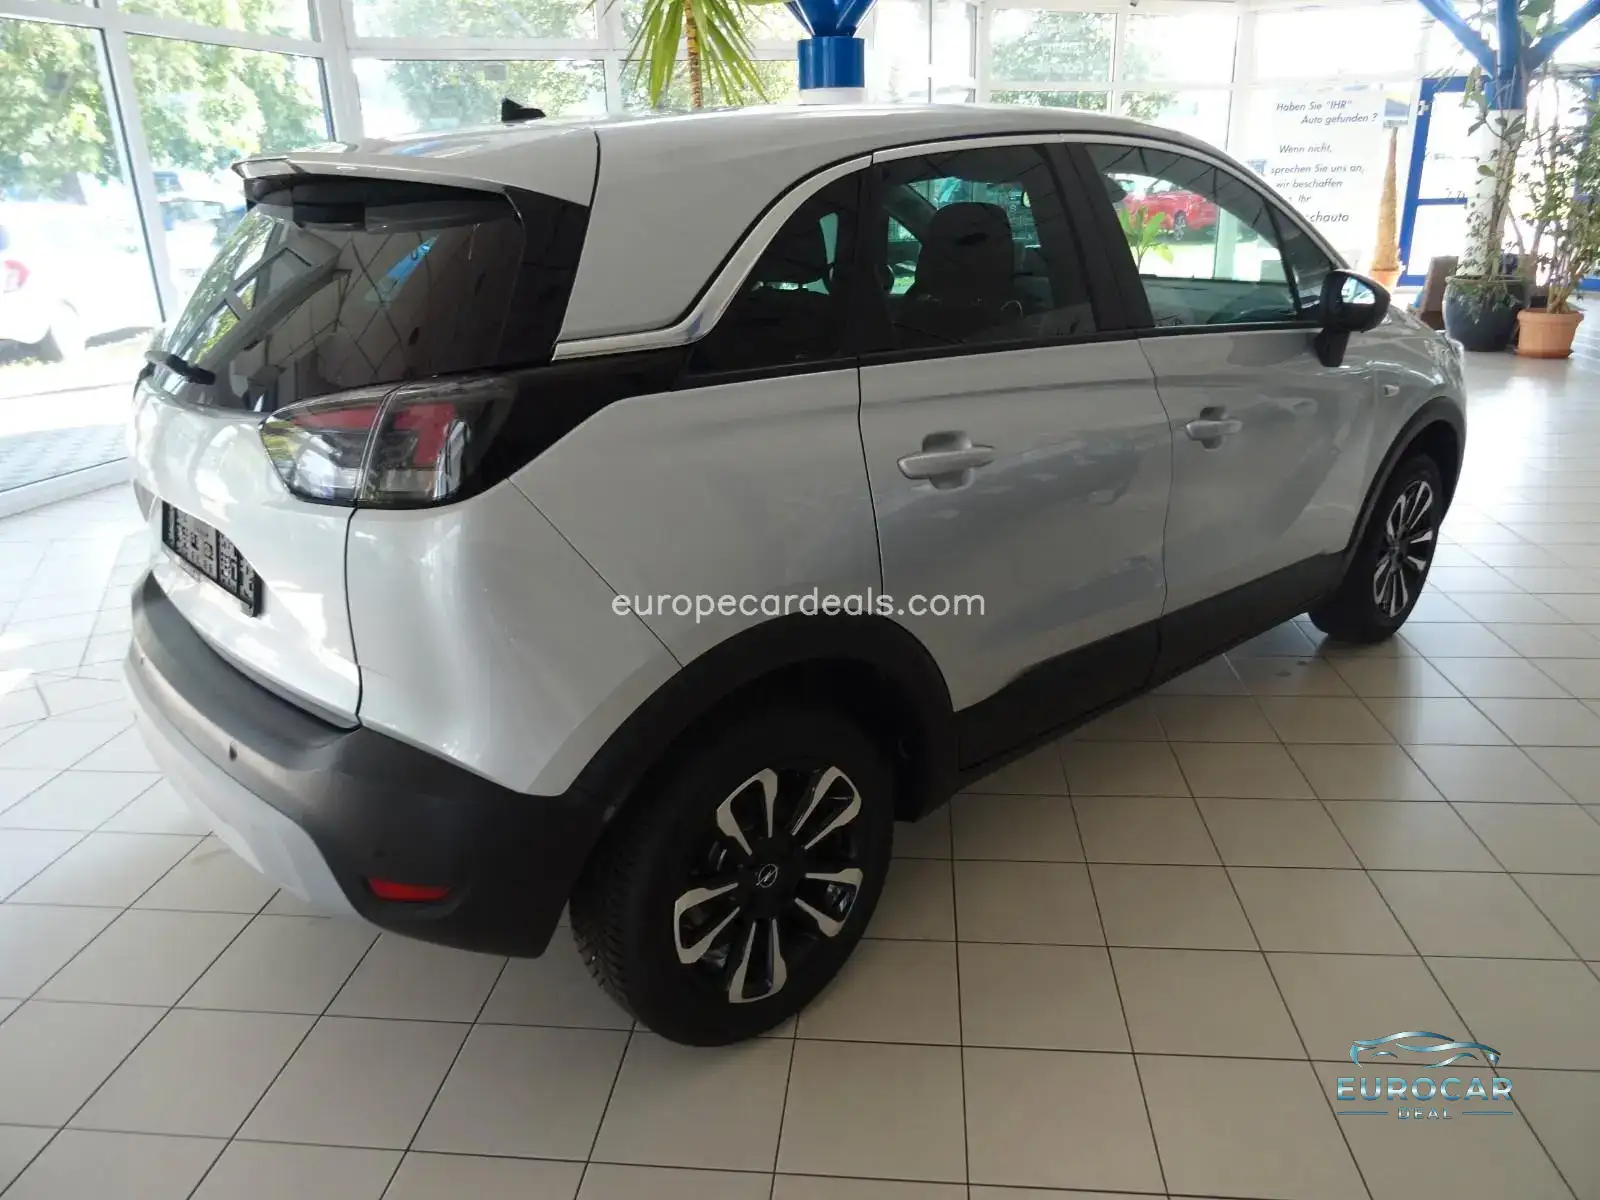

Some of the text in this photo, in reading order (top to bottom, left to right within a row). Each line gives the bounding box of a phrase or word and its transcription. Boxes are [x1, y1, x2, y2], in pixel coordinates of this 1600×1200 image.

[1276, 101, 1306, 111] Haben
[1309, 100, 1322, 110] Sie
[1301, 116, 1323, 124] Auto
[1325, 114, 1369, 126] gefunden
[1279, 144, 1305, 153] Wenn
[1271, 165, 1312, 175] sprechen
[1315, 164, 1329, 173] Sie
[1276, 179, 1343, 188] wir beschaffen
[1298, 195, 1312, 203] Ihr
[1306, 211, 1350, 223] chauto
